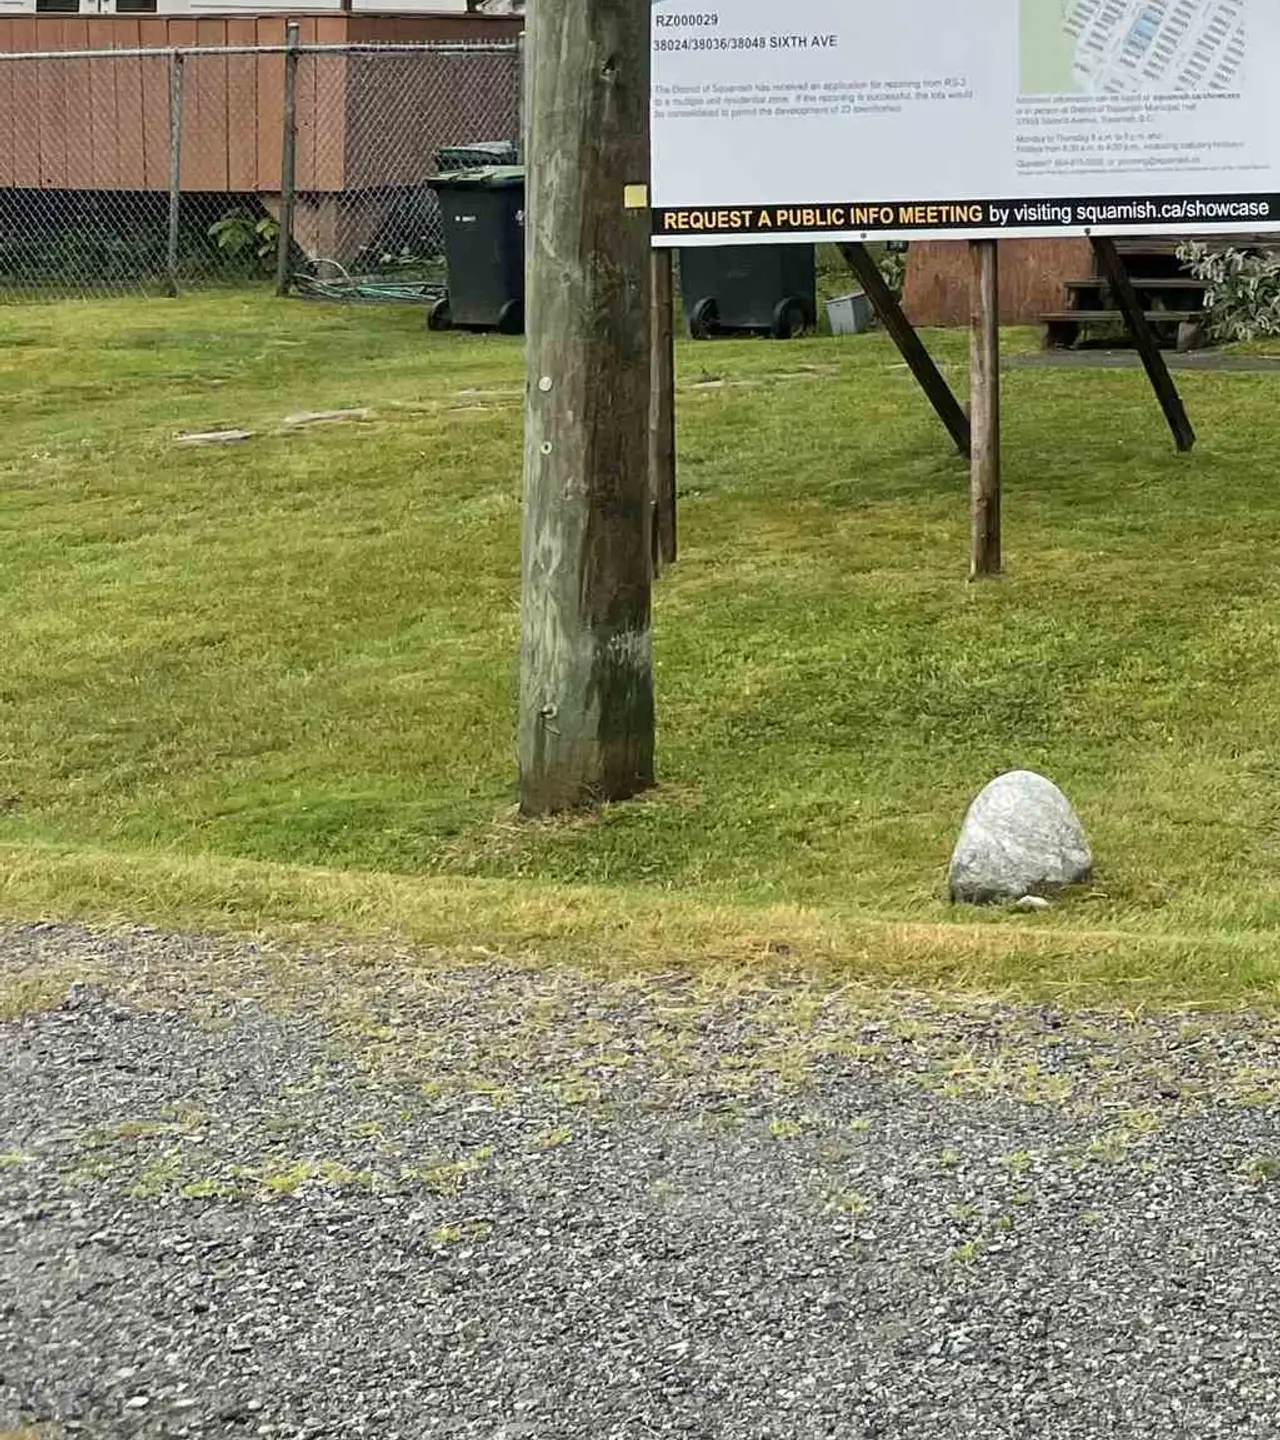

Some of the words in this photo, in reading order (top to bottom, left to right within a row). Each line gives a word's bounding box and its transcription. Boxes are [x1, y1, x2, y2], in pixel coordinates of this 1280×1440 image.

[656, 14, 718, 27] RZ000029
[653, 36, 766, 51] 38024/38036/38048
[769, 35, 807, 49] SIXTH
[811, 35, 838, 48] AVE
[663, 210, 753, 230] REQUEST
[758, 210, 772, 228] A
[776, 208, 845, 227] PUBLIC
[850, 207, 894, 225] INFO
[899, 205, 983, 224] MEETING
[989, 204, 1008, 225] by
[1013, 202, 1072, 224] visiting
[1076, 199, 1269, 224] squamish.ca/showcase
